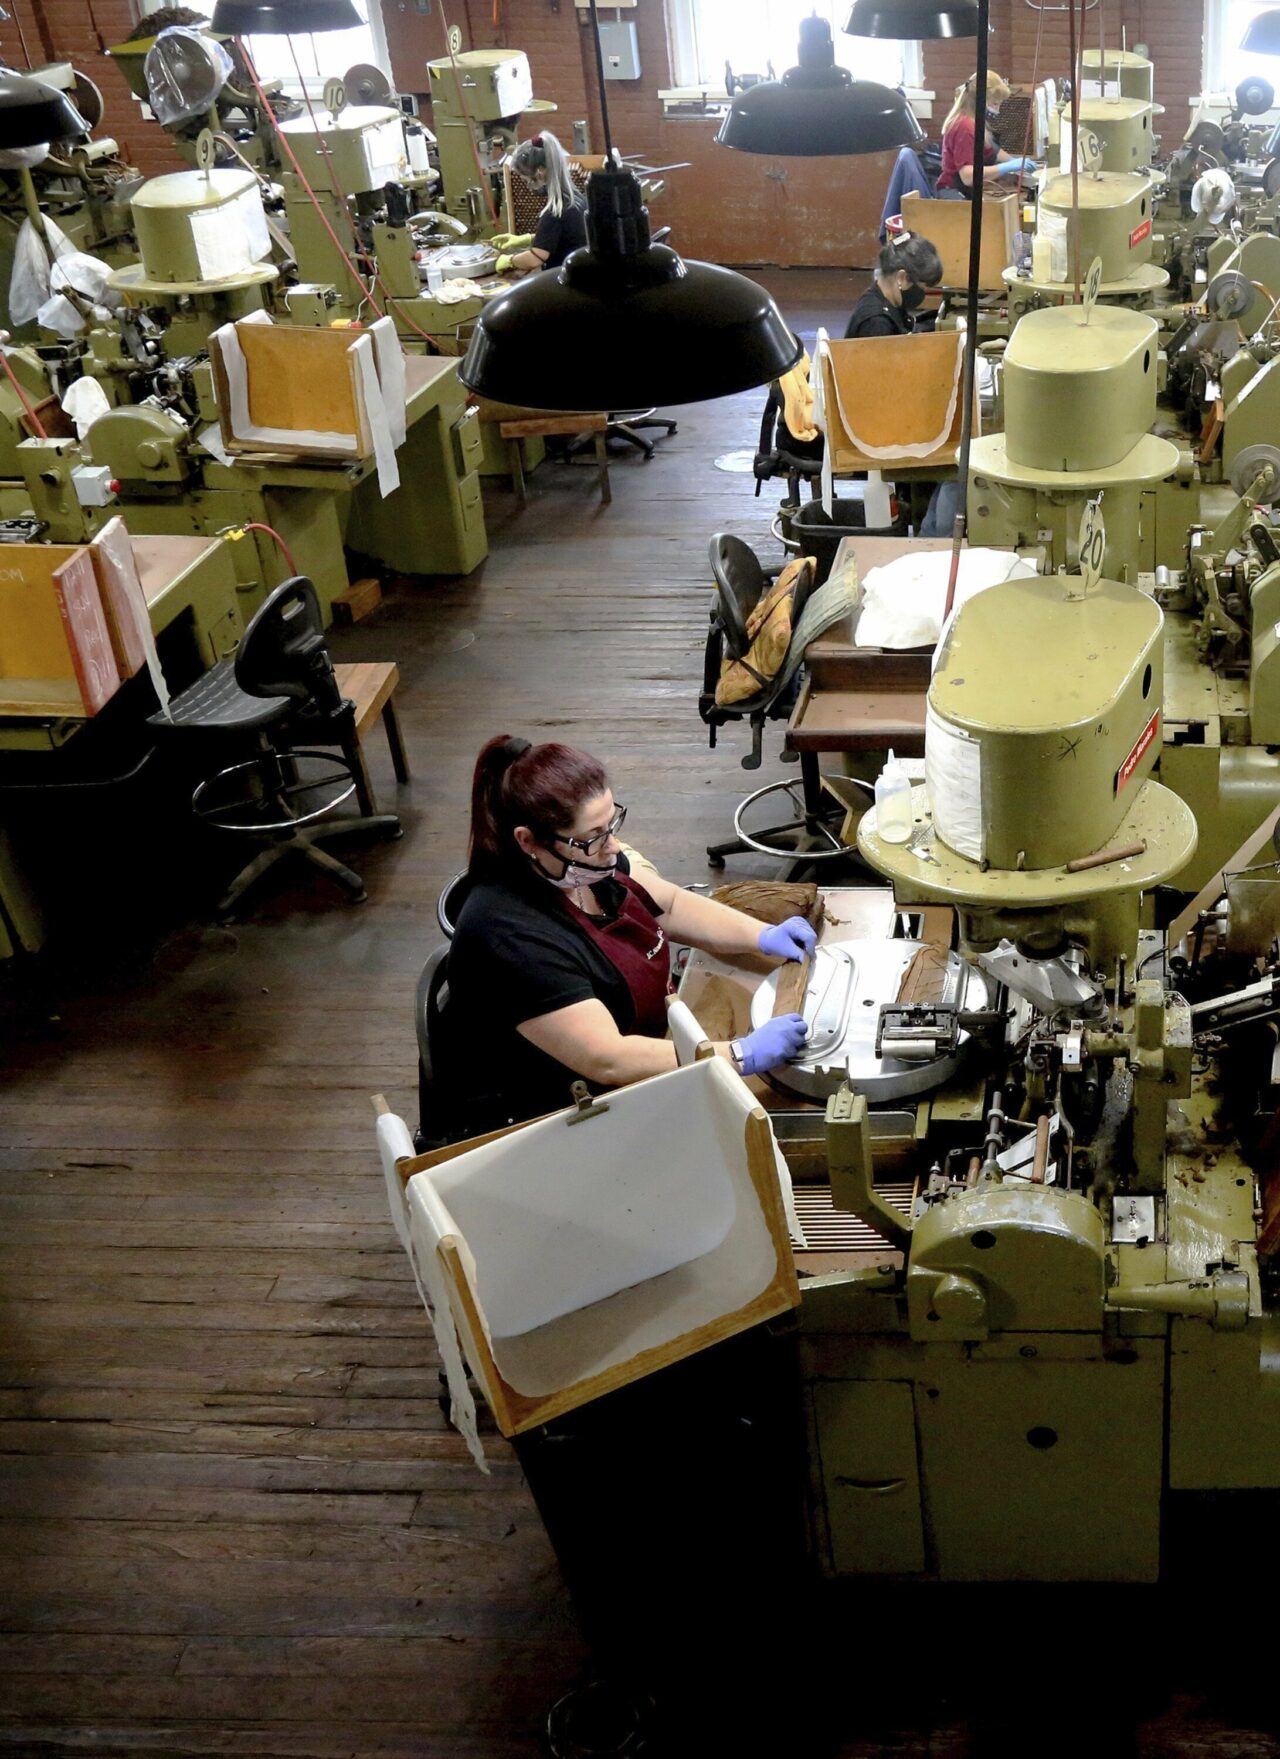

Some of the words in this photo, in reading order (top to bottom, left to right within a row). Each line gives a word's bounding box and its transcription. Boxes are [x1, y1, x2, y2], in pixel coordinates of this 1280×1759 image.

[329, 86, 345, 108] 10
[201, 139, 209, 162] 9
[1080, 134, 1099, 164] 16
[1087, 267, 1100, 300] 18
[1080, 529, 1103, 572] 20
